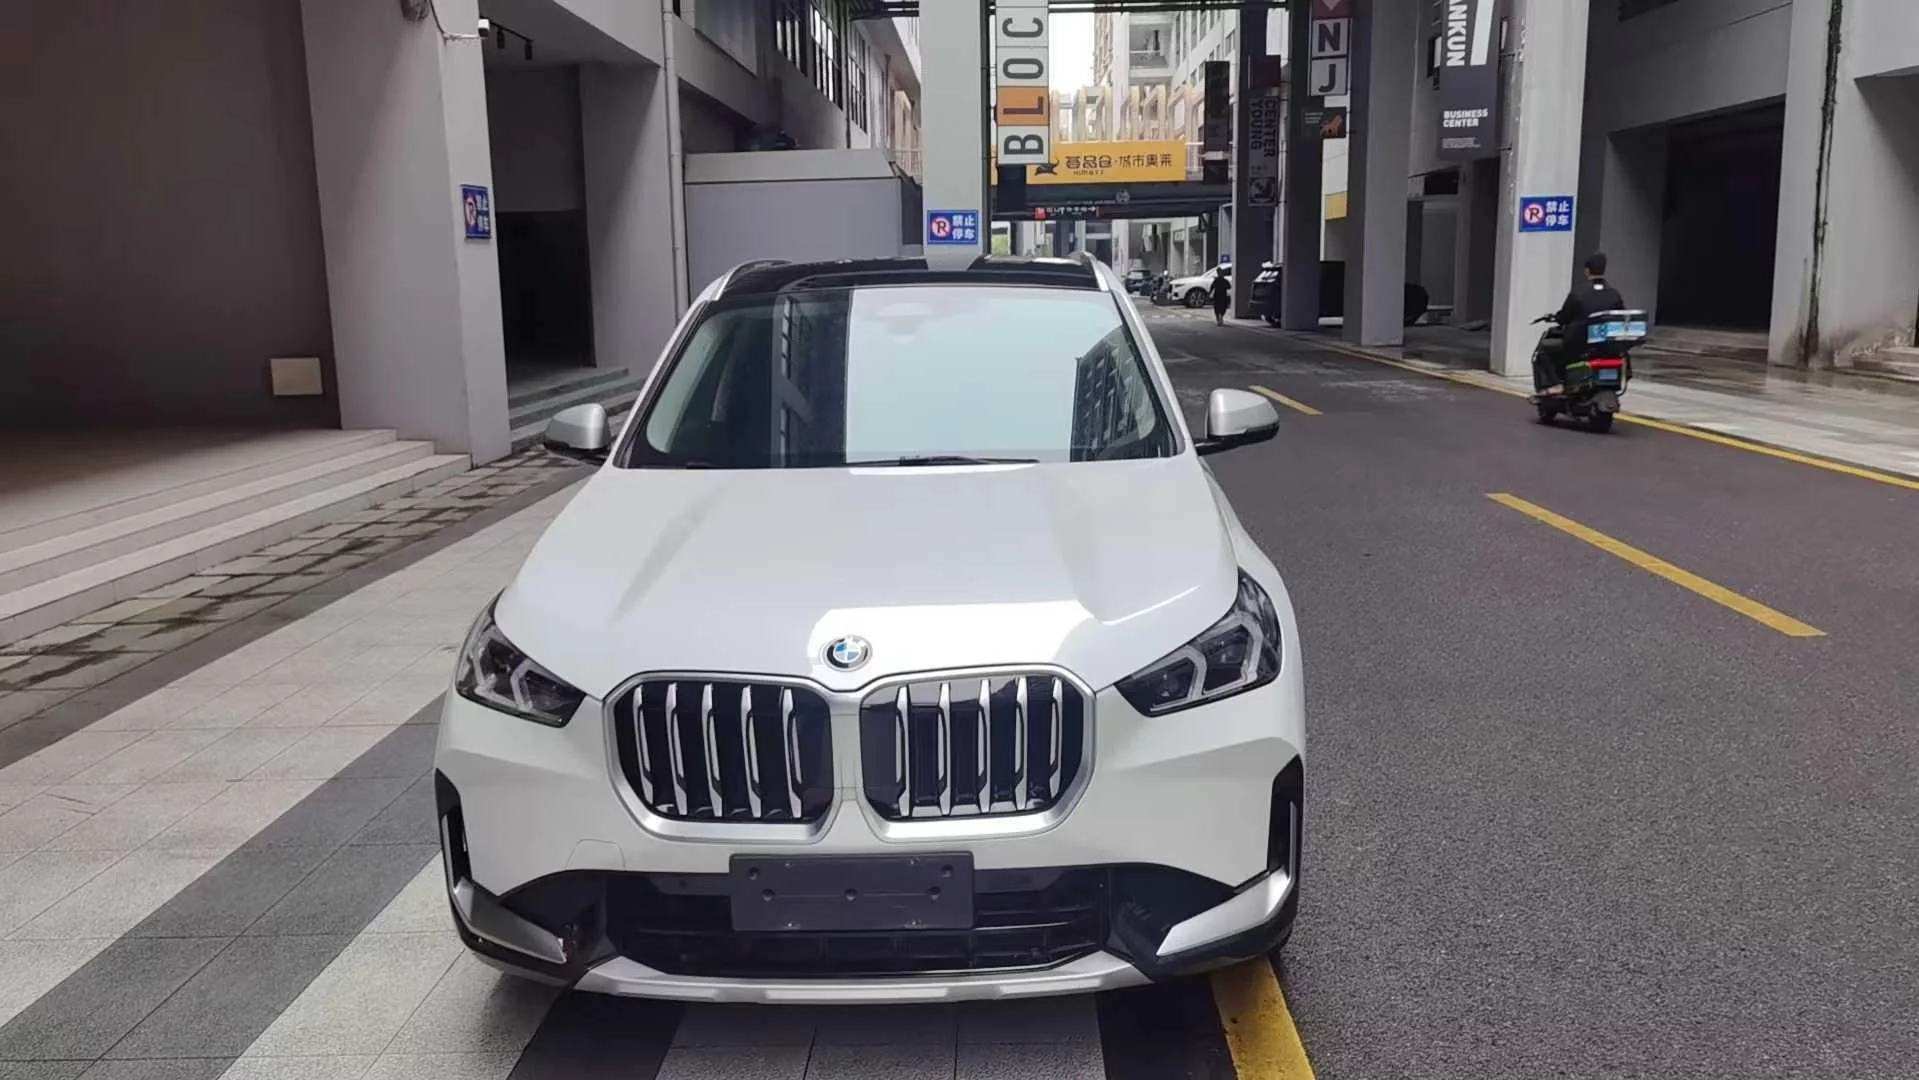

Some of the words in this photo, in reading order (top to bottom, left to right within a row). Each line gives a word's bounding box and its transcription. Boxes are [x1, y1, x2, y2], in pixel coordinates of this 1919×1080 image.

[1443, 108, 1488, 119] BUSINESS
[1443, 118, 1479, 128] CENTER
[1546, 200, 1570, 213] 禁止
[952, 215, 975, 227] 禁止
[1545, 214, 1569, 227] 停车
[952, 228, 975, 240] 停车
